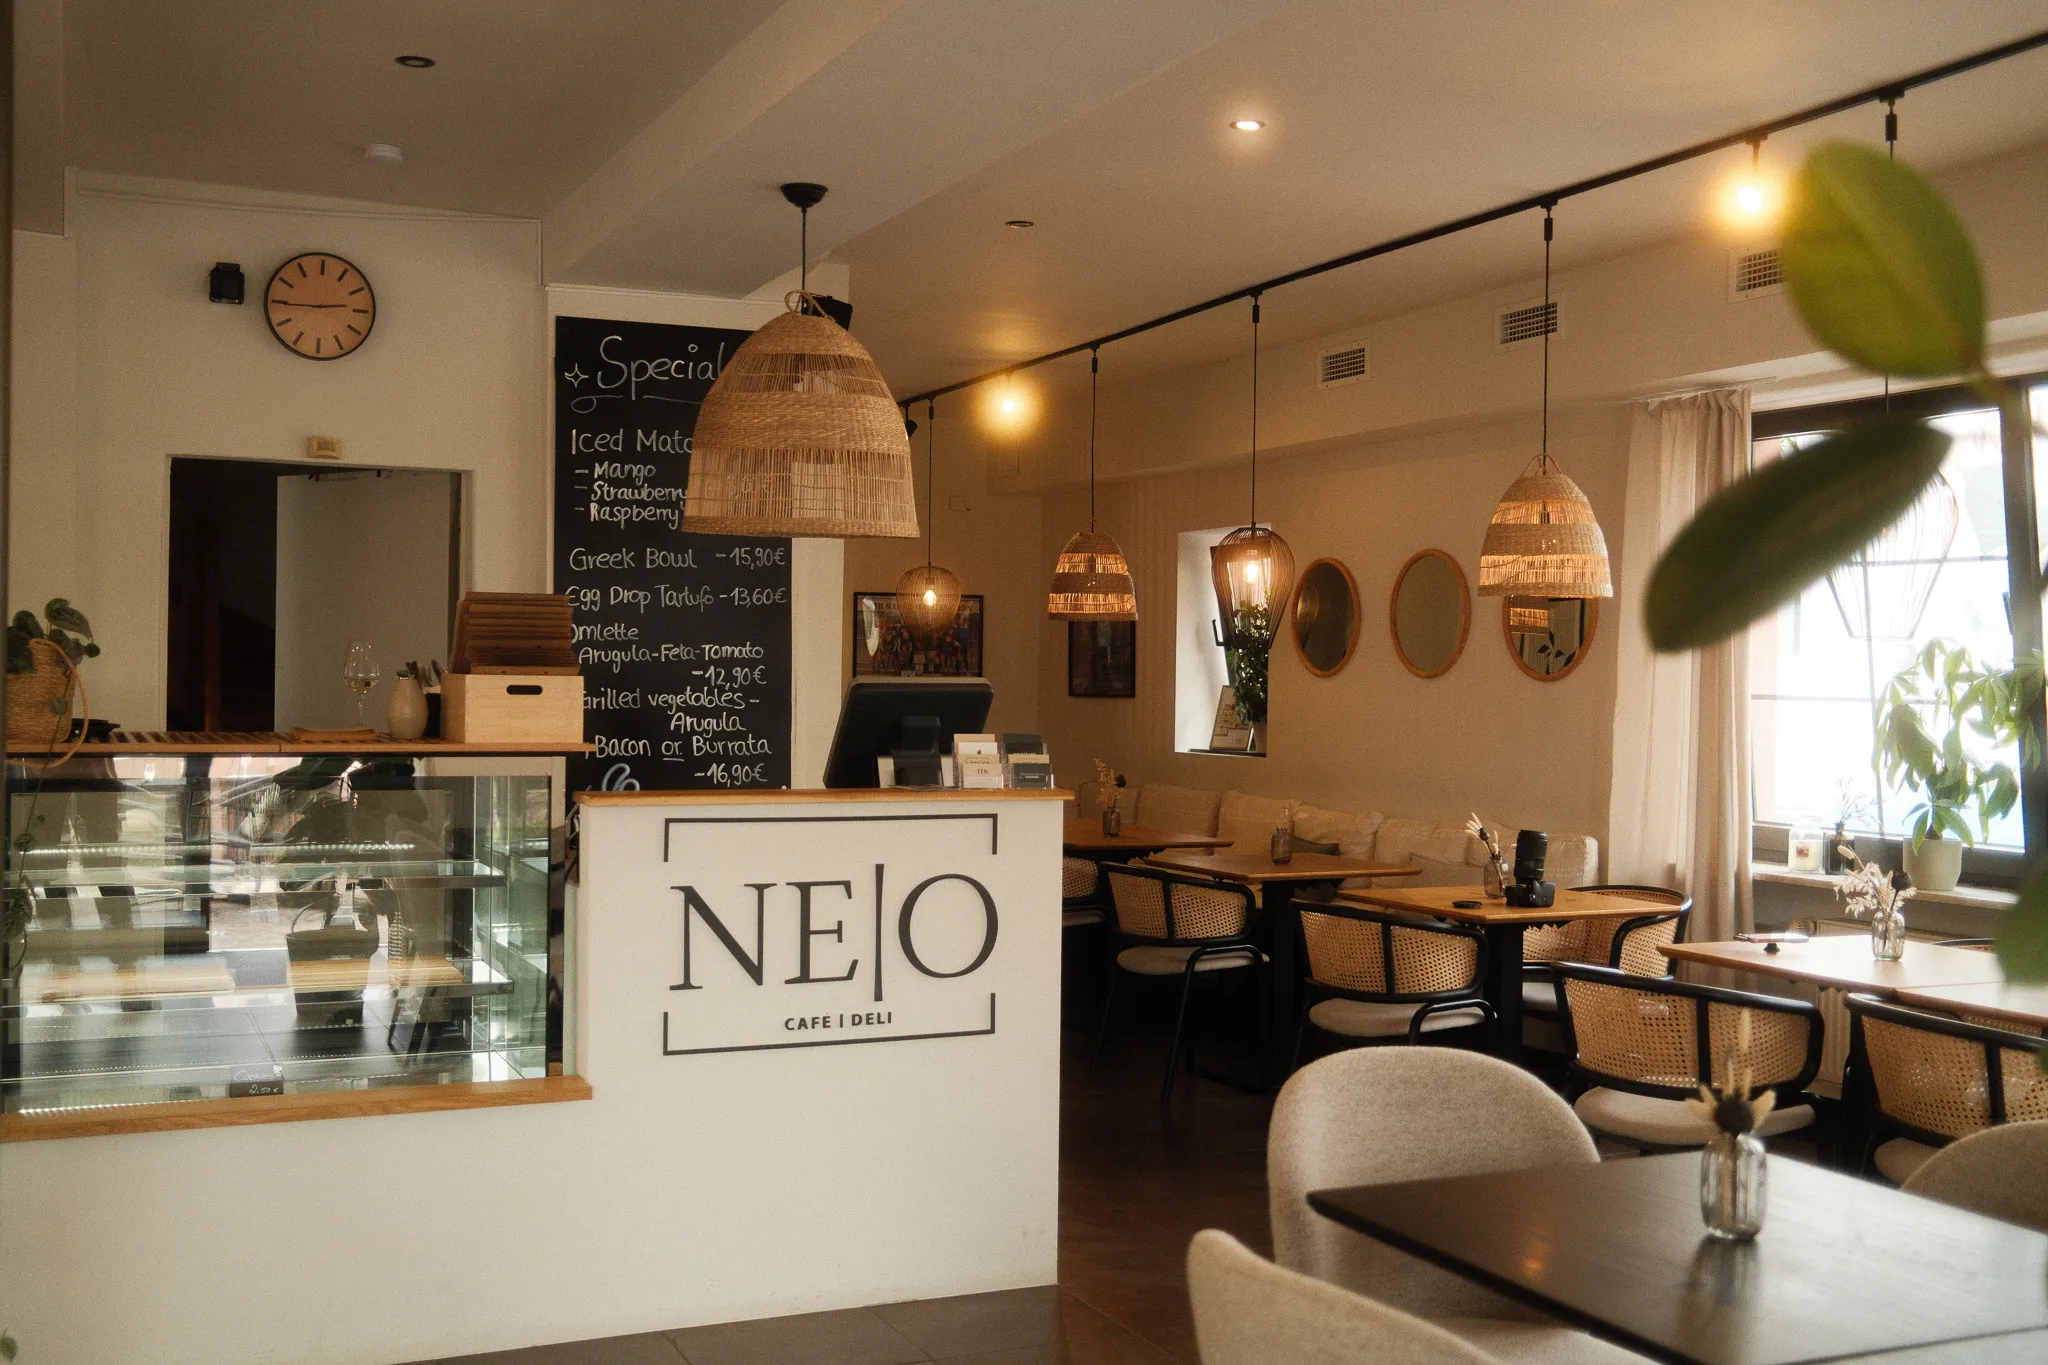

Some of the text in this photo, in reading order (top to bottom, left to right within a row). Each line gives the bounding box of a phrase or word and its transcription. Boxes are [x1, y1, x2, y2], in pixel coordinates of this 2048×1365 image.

[571, 428, 624, 455] Iced
[569, 547, 636, 571] Greek
[646, 547, 698, 569] Bowl
[565, 585, 601, 612] Egg
[610, 585, 651, 614] Drop
[654, 584, 715, 613] Tartufo
[571, 622, 639, 644] mlette
[670, 711, 747, 738] Arugula
[595, 734, 652, 759] Bacon
[692, 733, 773, 757] Burrata
[851, 1011, 892, 1026] DELI
